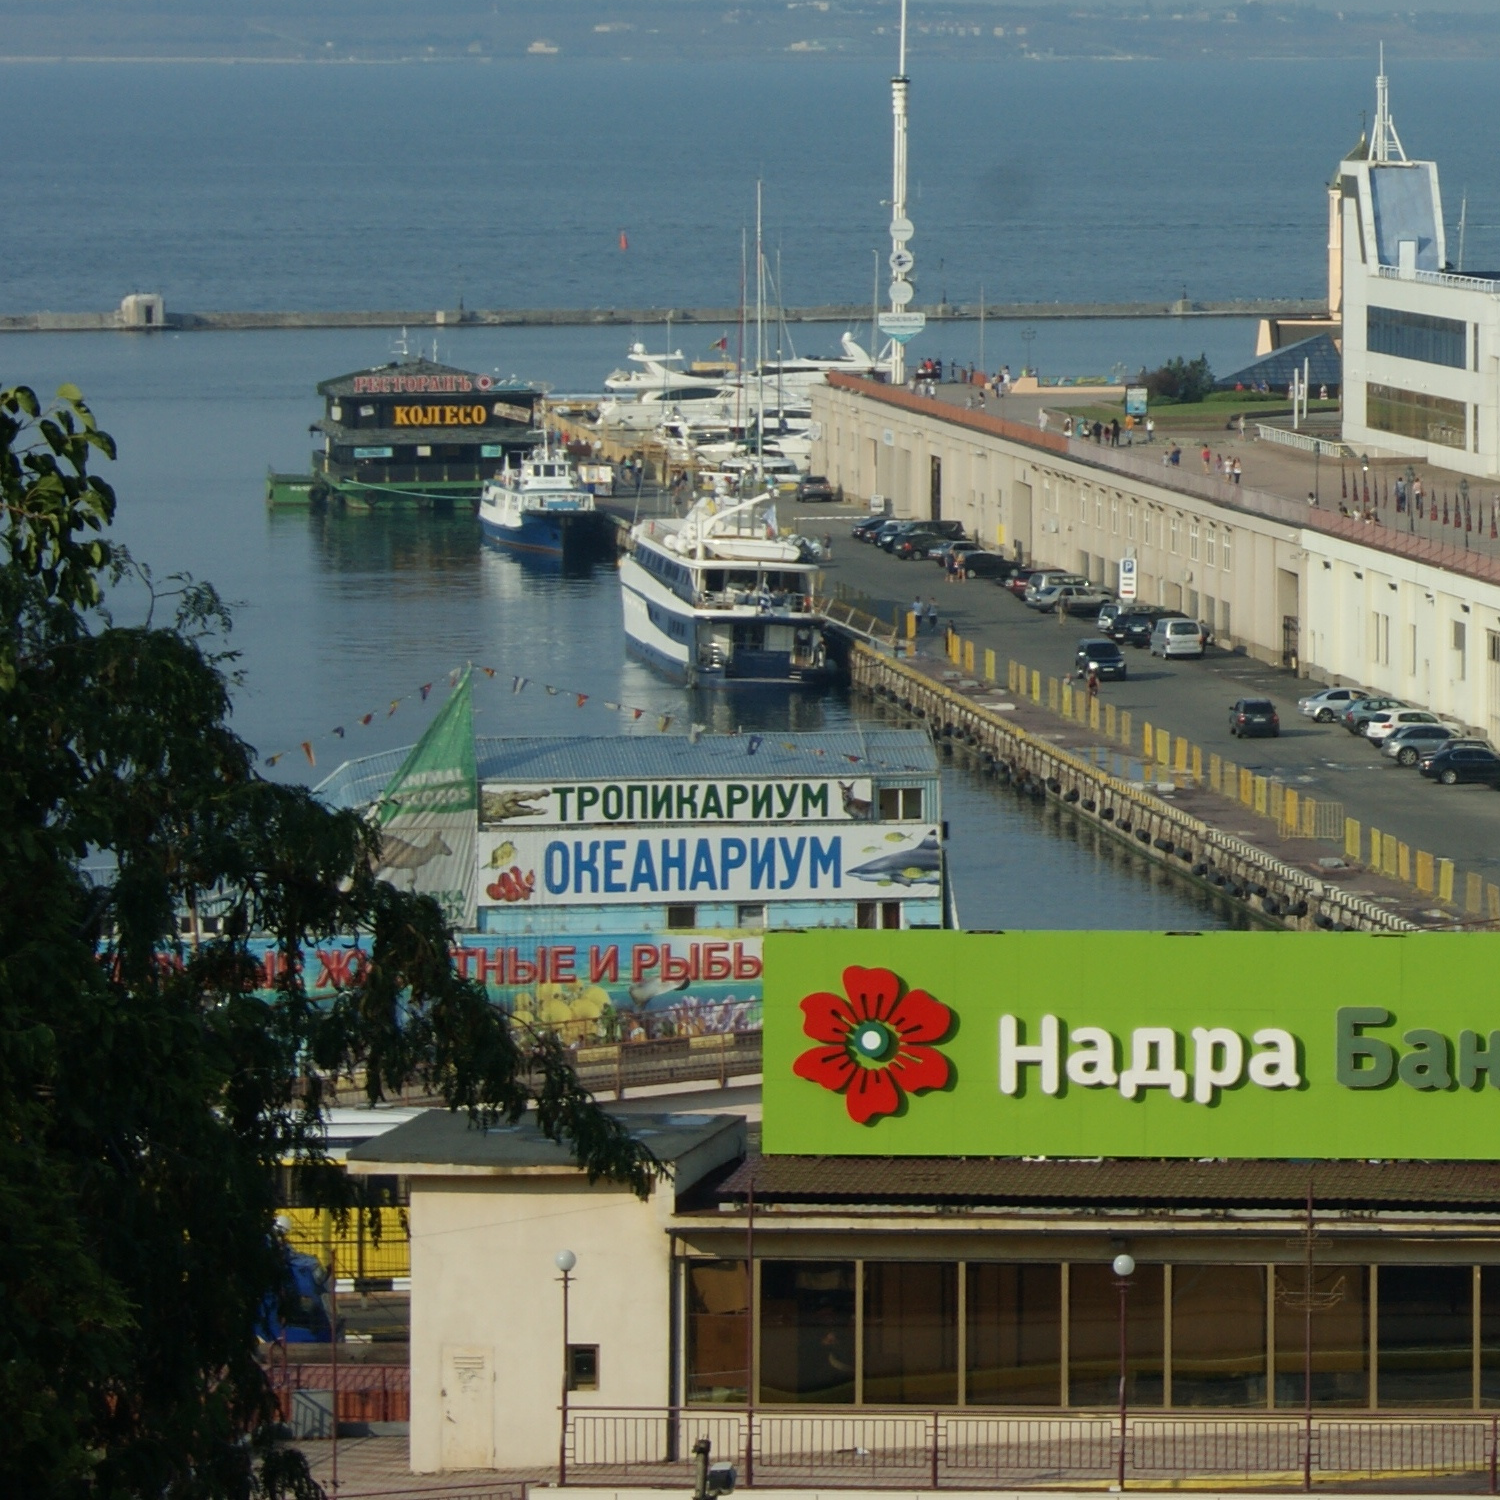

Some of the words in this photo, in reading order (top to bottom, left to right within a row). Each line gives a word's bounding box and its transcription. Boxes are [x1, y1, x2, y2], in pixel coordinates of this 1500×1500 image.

[353, 375, 473, 393] РЕСТОРАНЪ
[393, 405, 487, 426] КОЛЕСО
[552, 782, 829, 822] ТРОПИКАРИУМ
[544, 835, 842, 896] ОКЕАНАРИУМ
[590, 944, 618, 983] И
[998, 1013, 1301, 1106] Надра
